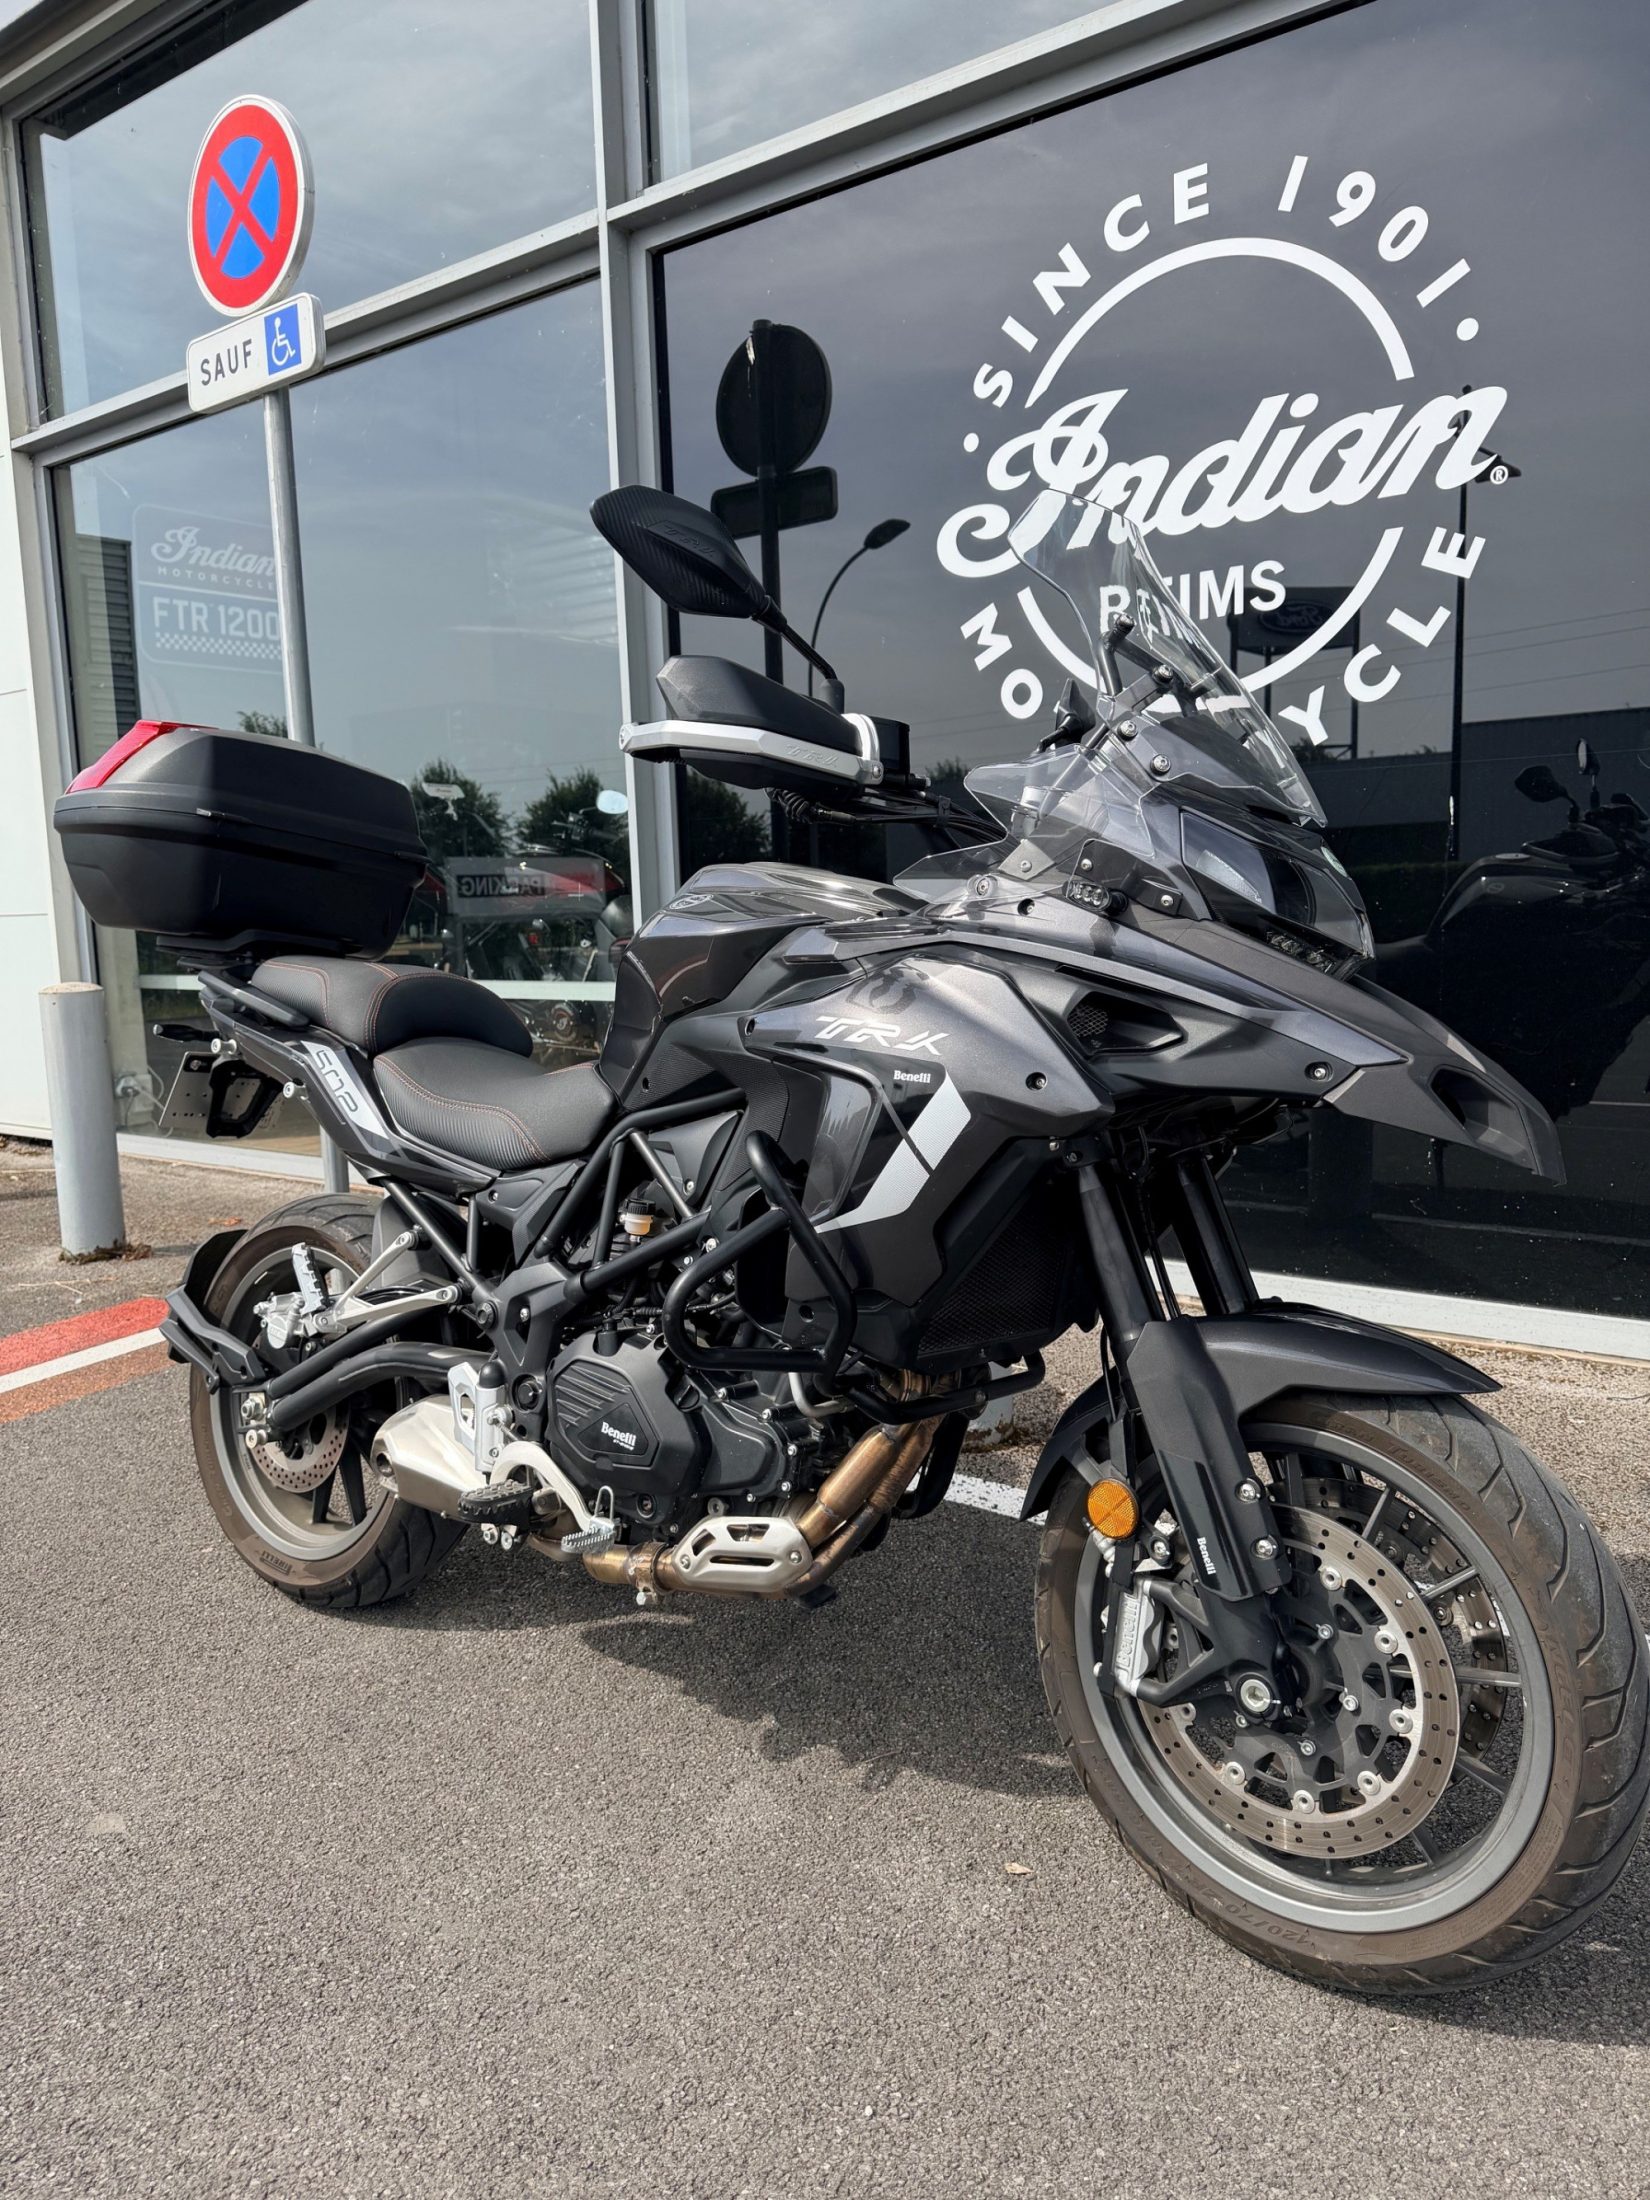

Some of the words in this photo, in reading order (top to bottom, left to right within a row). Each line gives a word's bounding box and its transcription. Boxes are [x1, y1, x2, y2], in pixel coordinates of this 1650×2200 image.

[973, 162, 1210, 408] SINCE
[1278, 154, 1472, 308] 1901
[200, 338, 252, 386] SAUF
[936, 385, 1508, 578] Indian
[150, 525, 275, 577] Indian
[152, 596, 208, 634] FTR
[217, 604, 281, 641] 1200
[960, 526, 1486, 747] MOYCLE
[814, 1015, 951, 1056] TRK
[315, 1049, 359, 1113] 502
[893, 1069, 932, 1084] Benelli
[601, 1421, 637, 1447] Benelli
[1196, 1536, 1217, 1576] Benelli
[1116, 1600, 1138, 1668] Benelli
